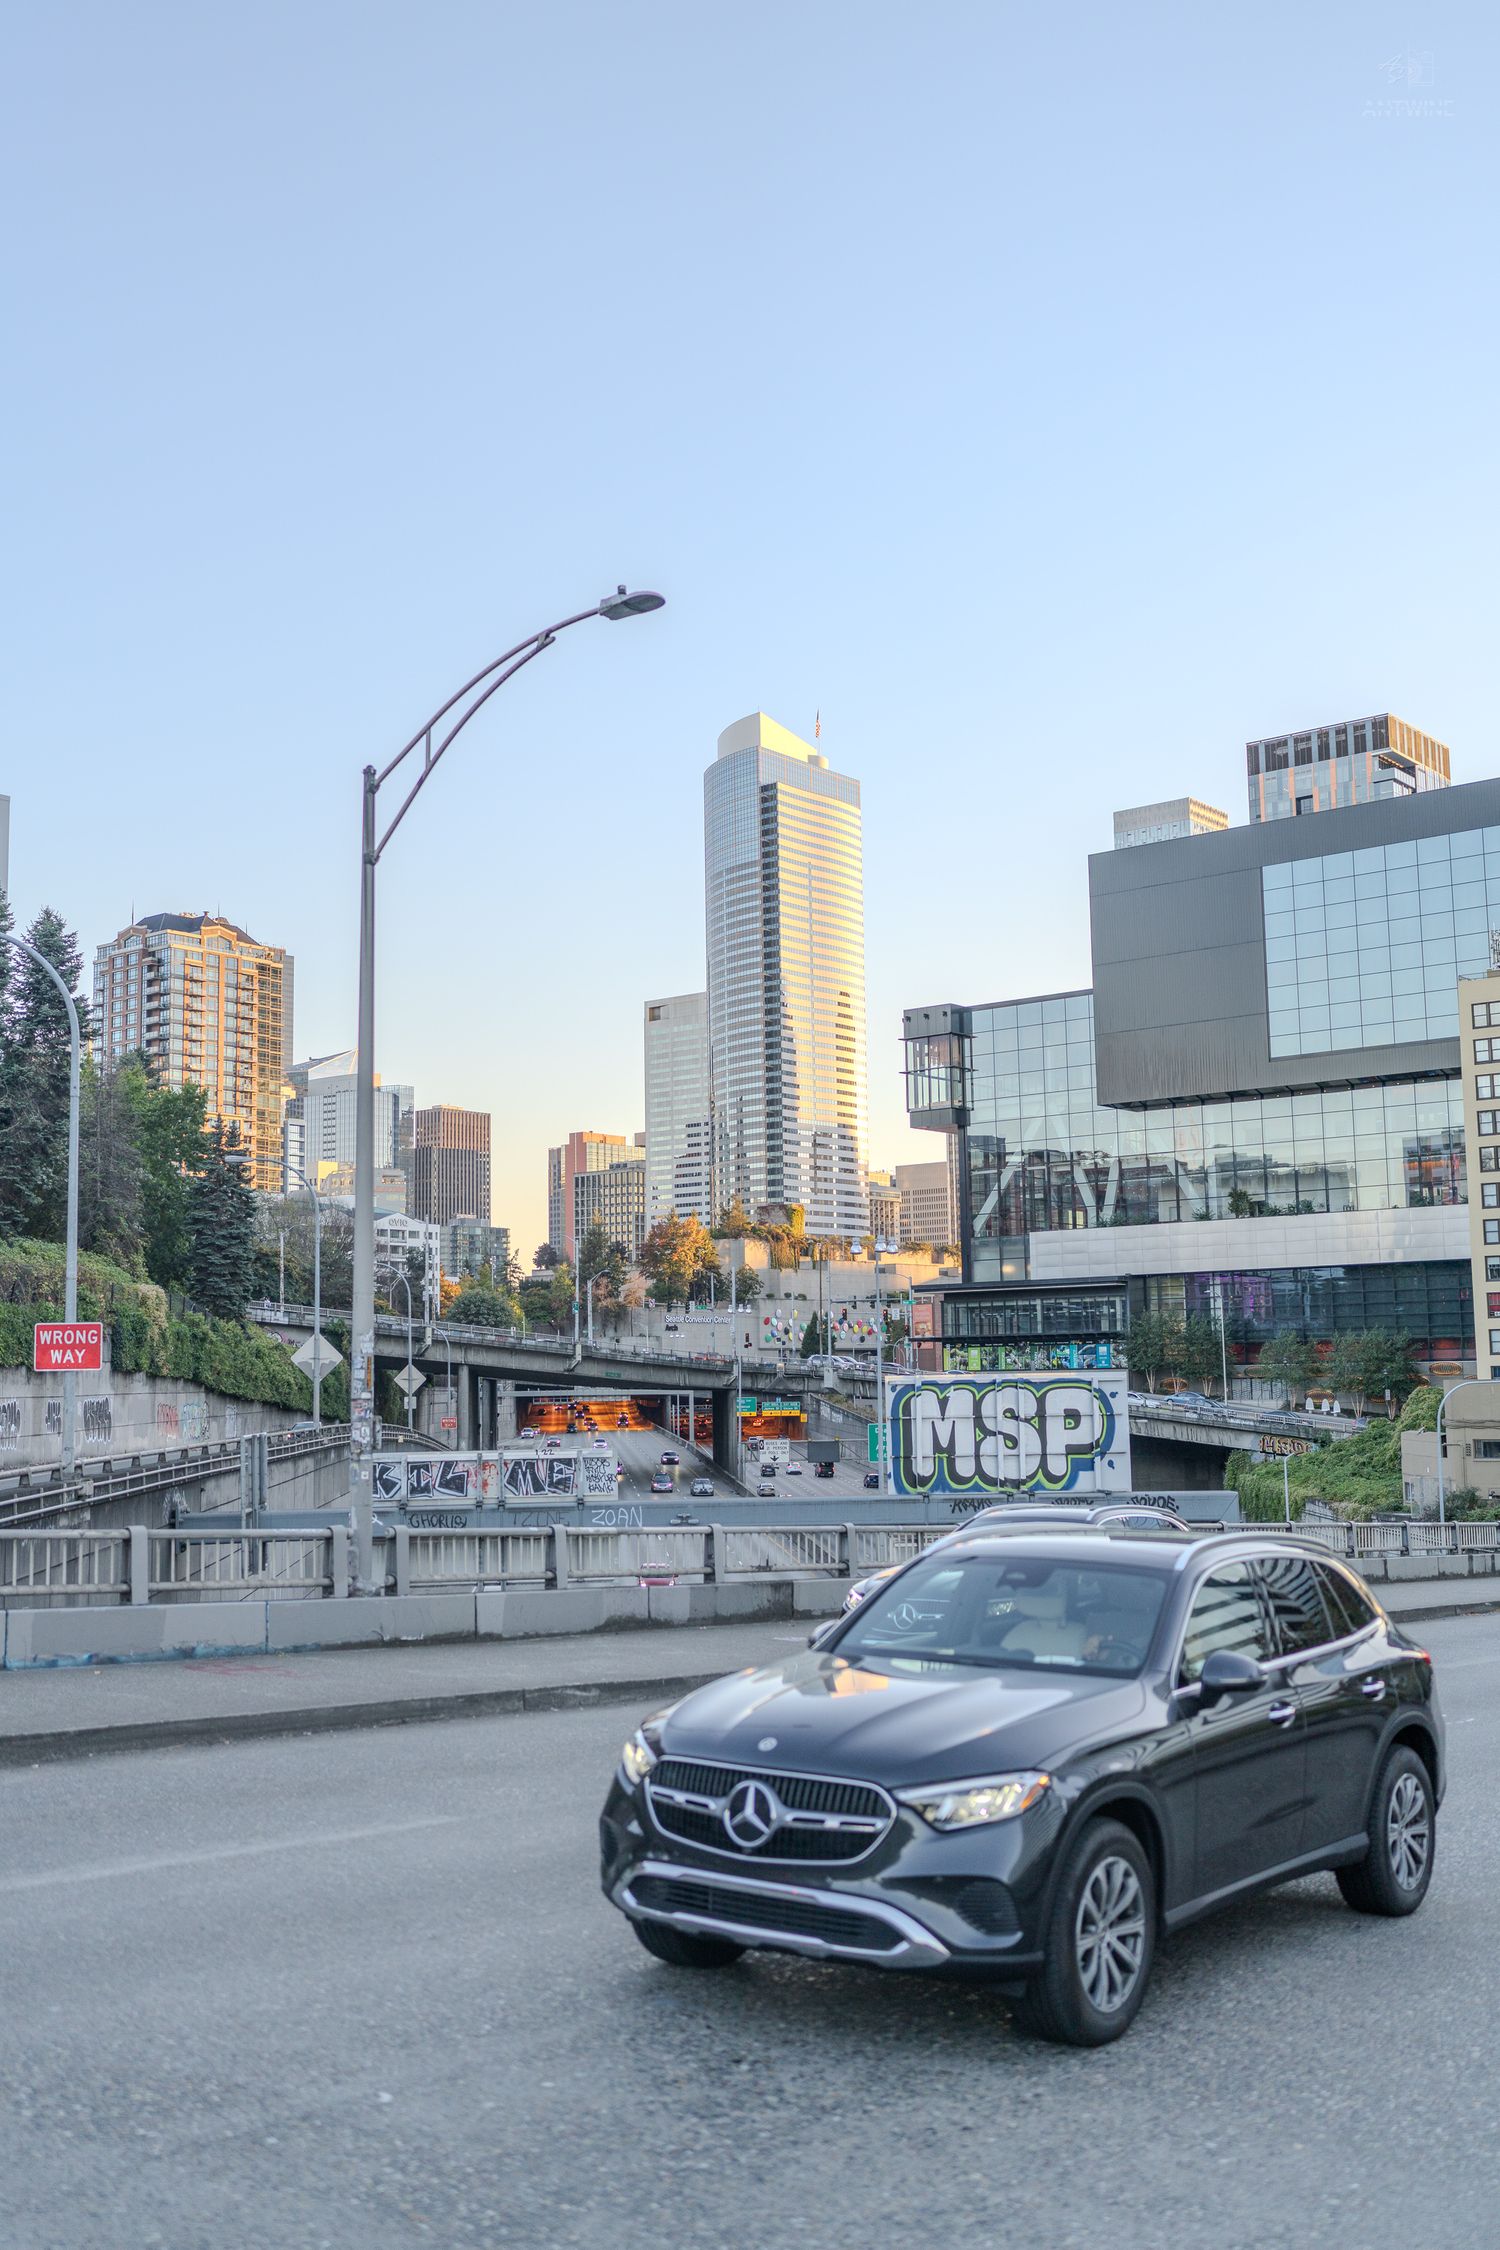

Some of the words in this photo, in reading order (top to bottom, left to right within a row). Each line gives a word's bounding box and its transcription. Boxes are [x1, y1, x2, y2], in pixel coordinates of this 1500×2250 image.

[665, 1314, 685, 1324] Seattle
[685, 1315, 713, 1324] Convention
[713, 1316, 731, 1325] Center
[39, 1329, 98, 1345] WRONG
[50, 1348, 86, 1364] WAY
[901, 1383, 1106, 1490] MSP
[591, 1506, 642, 1528] ZOAN
